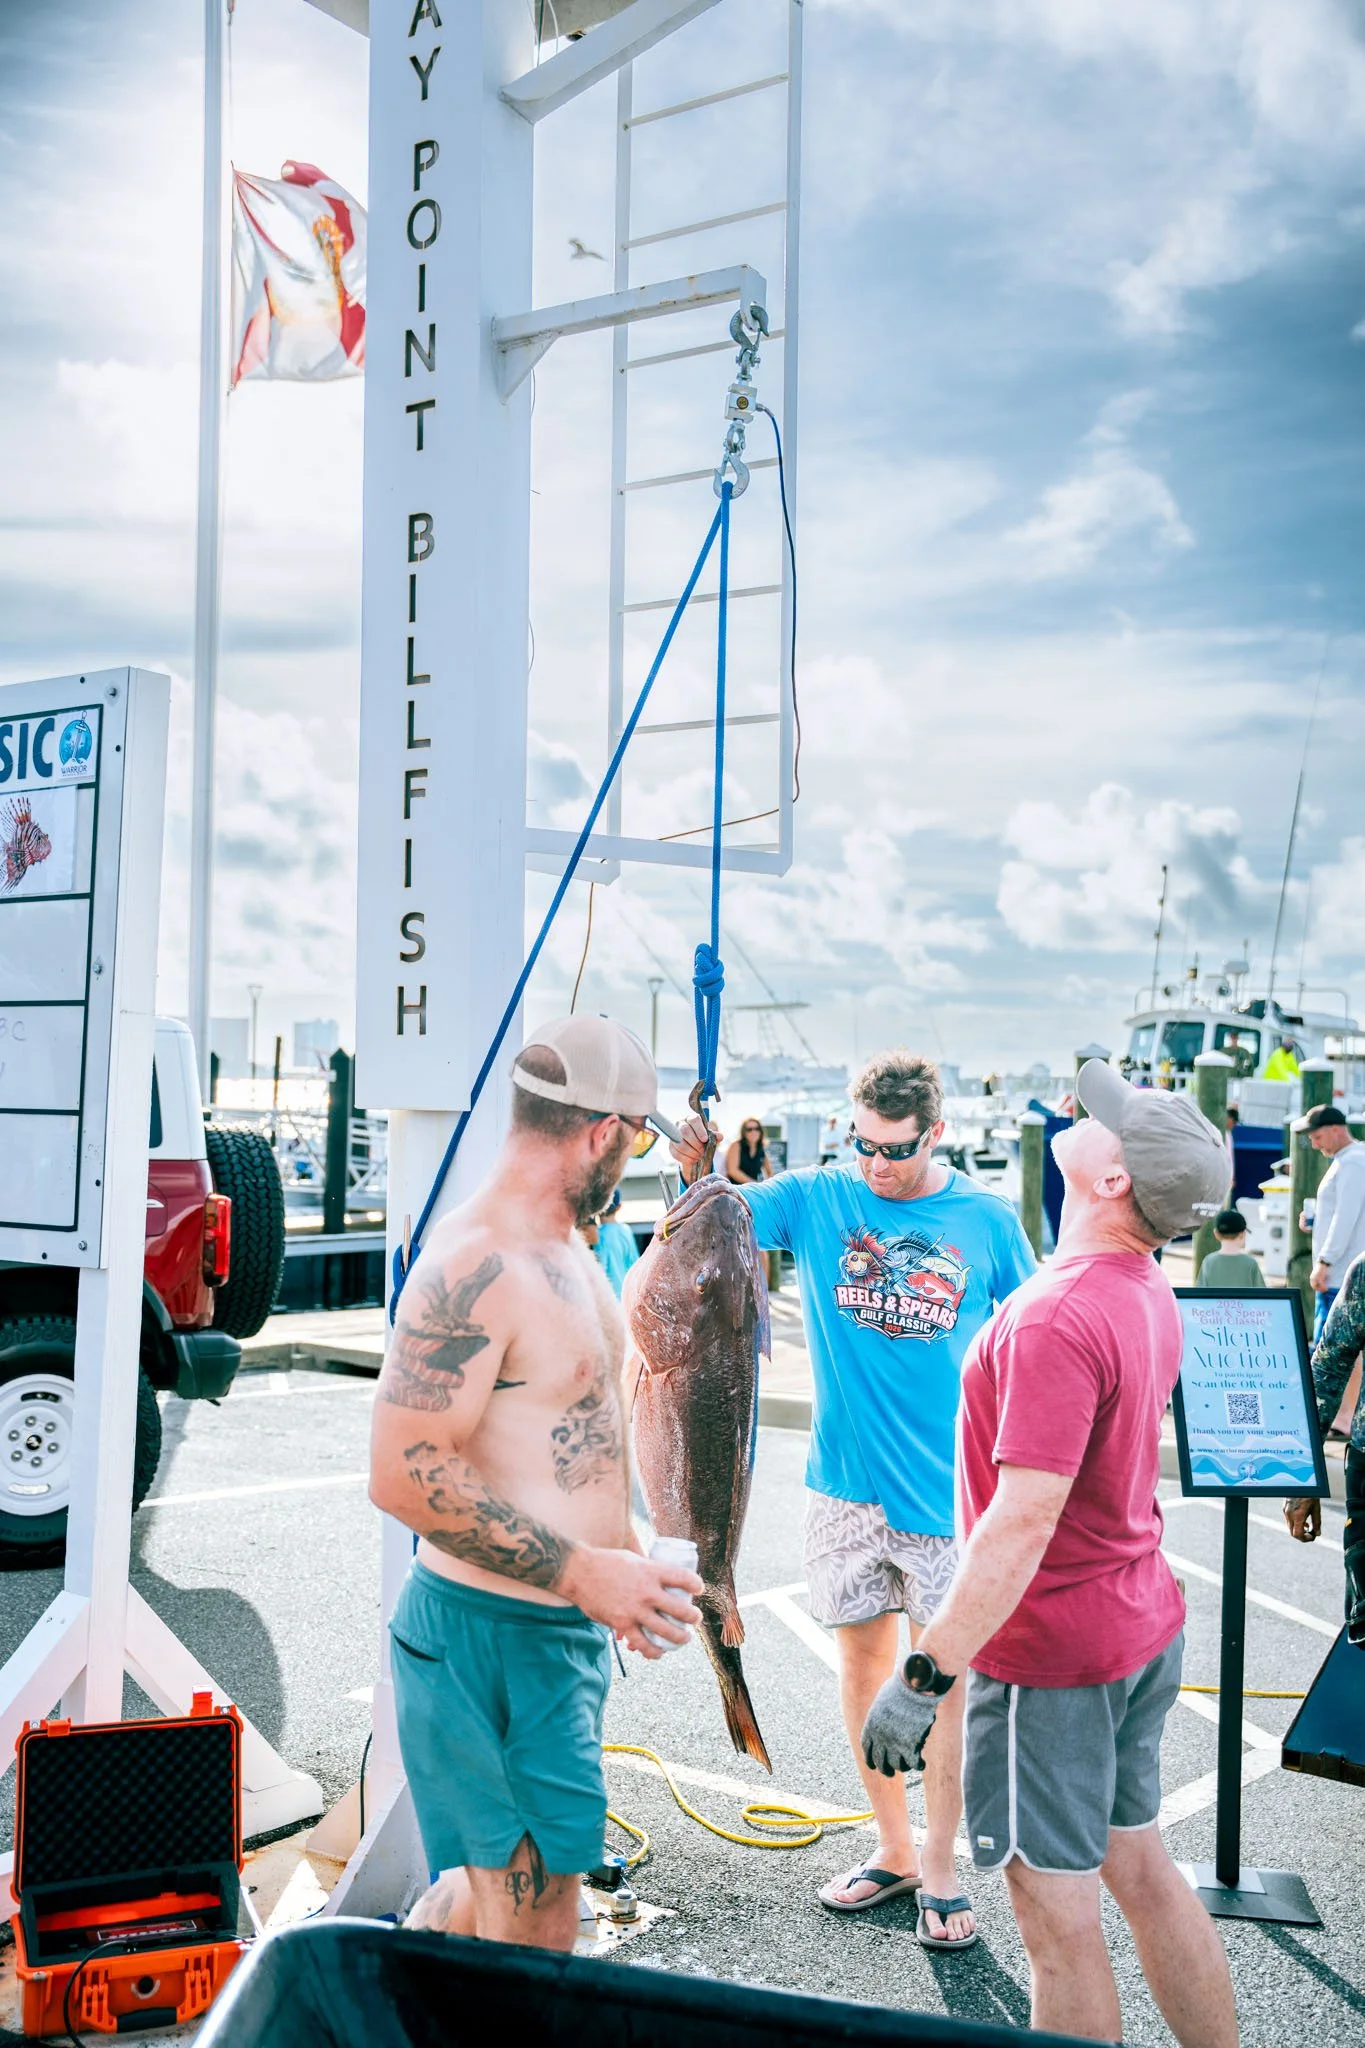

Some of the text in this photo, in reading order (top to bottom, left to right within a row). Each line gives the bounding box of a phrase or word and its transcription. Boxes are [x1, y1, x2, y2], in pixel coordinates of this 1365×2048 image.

[396, 0, 442, 1036] AY POINT BILLFISH
[0, 717, 55, 783] SIC
[61, 765, 88, 775] WARRIOR
[836, 1286, 958, 1330] REELS & SPEARS
[1191, 1307, 1273, 1319] Reels & Spears
[860, 1308, 931, 1333] GULF CLASSIC
[1200, 1316, 1266, 1326] Gulf Classic
[1201, 1325, 1267, 1347] Silent
[1193, 1346, 1288, 1369] Auction
[1191, 1380, 1217, 1389] Scan
[1220, 1380, 1237, 1389] the
[1259, 1380, 1289, 1389] Code
[1192, 1427, 1216, 1435] Thank
